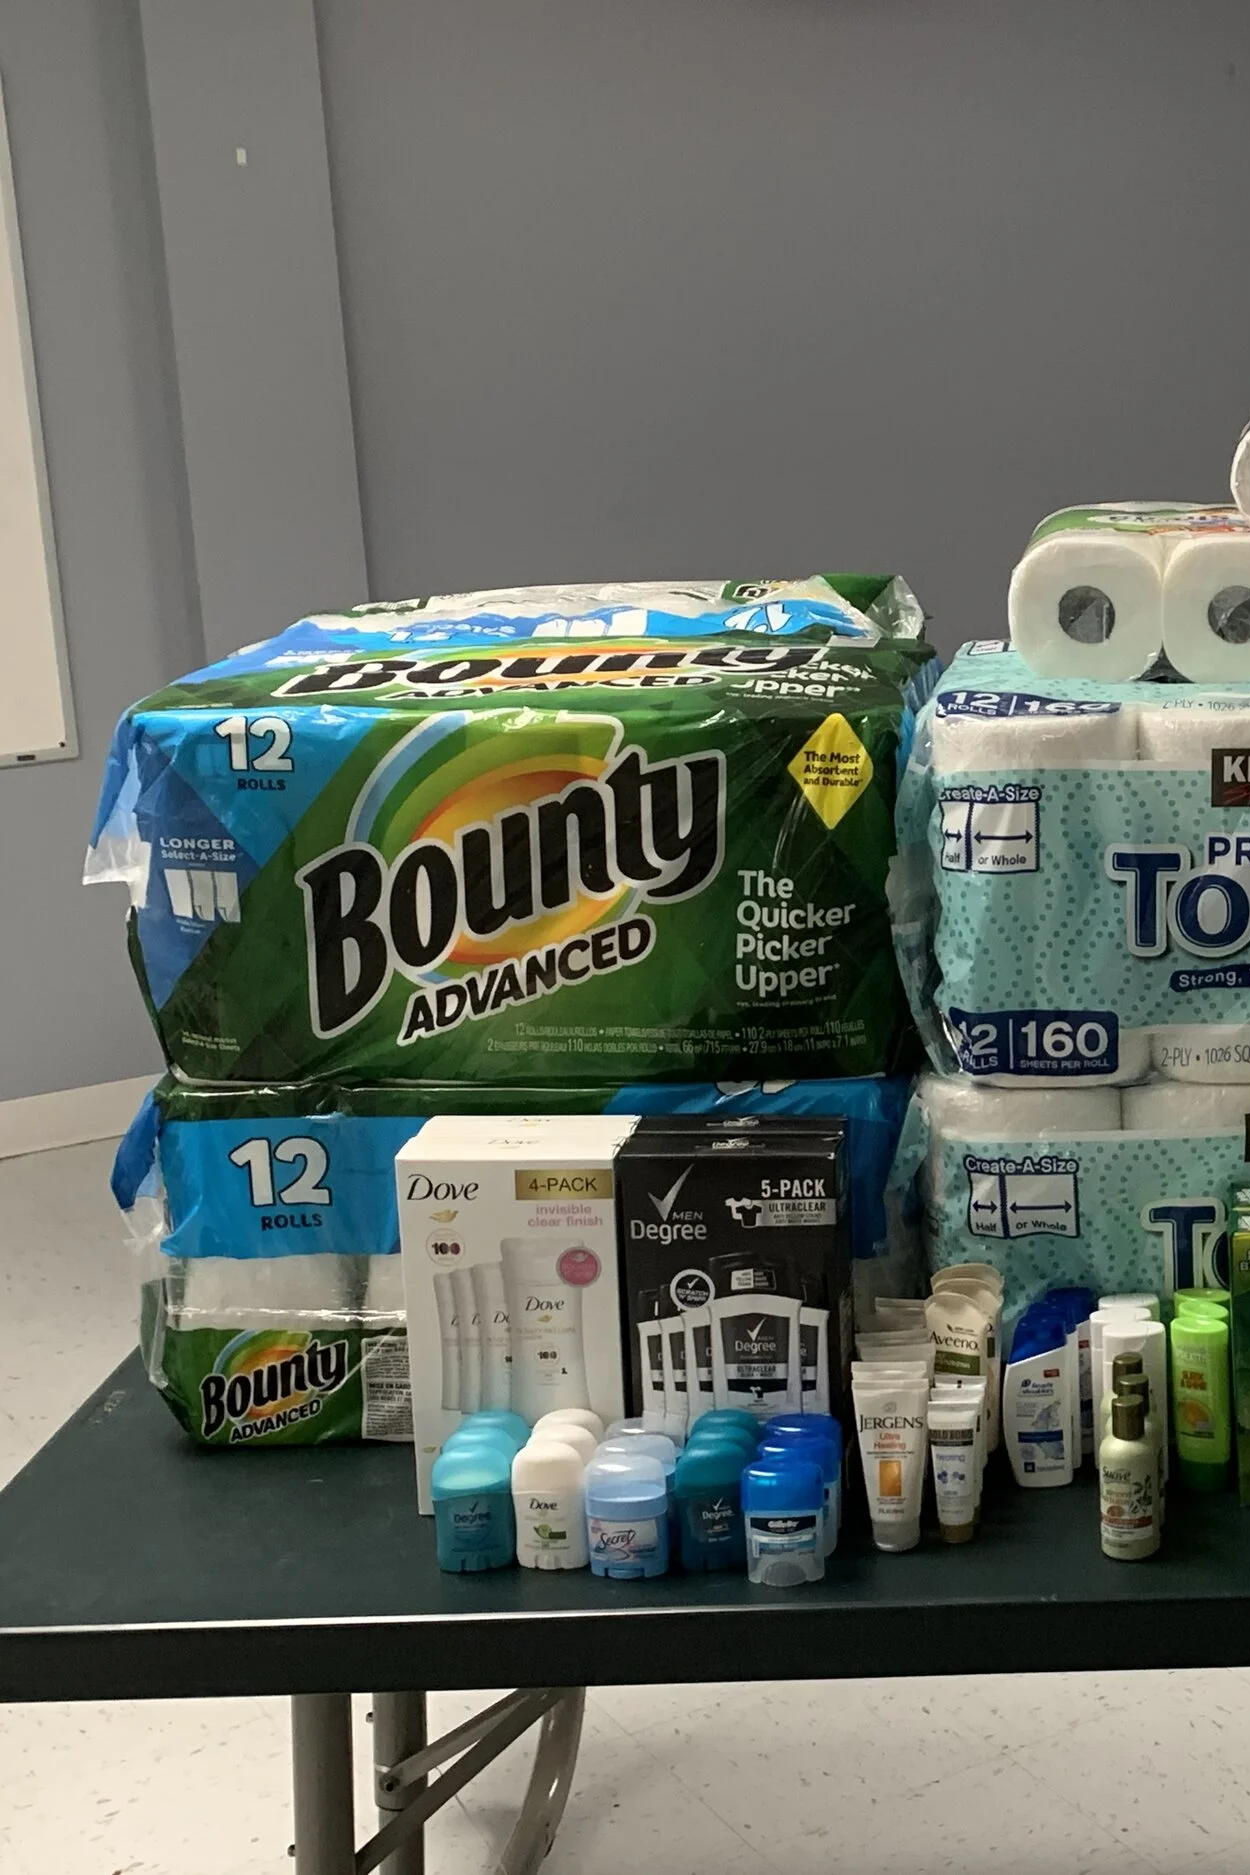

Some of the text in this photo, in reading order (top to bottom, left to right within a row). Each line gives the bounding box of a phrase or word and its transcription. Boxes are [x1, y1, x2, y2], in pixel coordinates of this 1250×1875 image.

[274, 646, 826, 695] Bounty
[378, 674, 721, 700] ADVANCED
[951, 691, 1001, 709] 12
[214, 715, 295, 773] 12
[803, 751, 861, 764] The Most
[803, 764, 859, 776] Absorbent
[236, 777, 287, 791] ROLLS
[803, 777, 820, 786] and
[159, 836, 236, 850] LONGER
[160, 849, 237, 862] Select-A-Size
[977, 855, 988, 866] or
[988, 853, 1027, 866] Whole
[299, 747, 726, 1036] Bounty
[737, 870, 795, 899] The
[736, 901, 856, 931] Quicker
[735, 933, 833, 962] Picker
[401, 915, 654, 1041] ADVANCED
[735, 963, 833, 997] Upper
[1178, 968, 1243, 988] Strong,
[1020, 1020, 1109, 1059] 160
[1019, 1058, 1110, 1069] SHEETS PER ROLL
[1160, 1046, 1193, 1067] 2-PLY
[1204, 1046, 1232, 1066] 1026
[1233, 1044, 1250, 1064] SQ
[228, 1135, 333, 1207] 12
[965, 1157, 1079, 1175] Create-A-Size
[406, 1172, 480, 1201] Dove
[527, 1176, 599, 1193] 4-PACK
[760, 1179, 827, 1199] 5-PACK
[535, 1203, 593, 1216] invisible
[671, 1210, 704, 1222] MEN
[768, 1202, 827, 1213] ULTRACLEAR
[261, 1212, 324, 1231] ROLLS
[527, 1214, 604, 1228] clear finish
[975, 1219, 1068, 1233] Half or Whole
[630, 1219, 708, 1246] Degree
[524, 1295, 566, 1312] Dove
[734, 1340, 777, 1355] Degree
[201, 1339, 348, 1438] Bounty
[230, 1399, 323, 1442] ADVANCED
[859, 1414, 924, 1433] JERGENS
[529, 1498, 560, 1511] Dove
[600, 1528, 637, 1548] Secret
